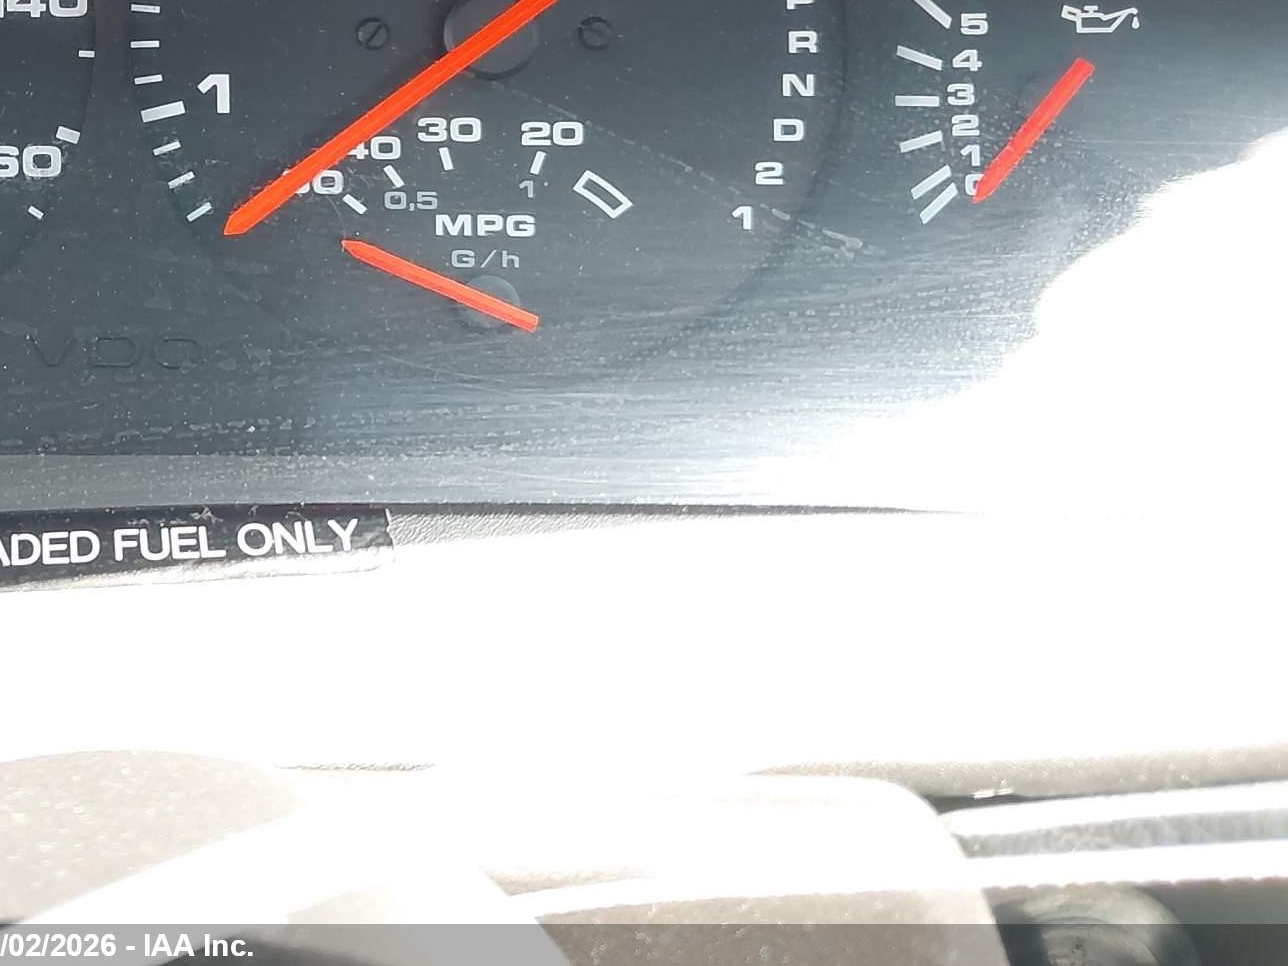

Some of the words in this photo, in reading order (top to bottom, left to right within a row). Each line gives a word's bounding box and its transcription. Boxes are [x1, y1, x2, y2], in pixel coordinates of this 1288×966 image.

[960, 13, 989, 35] 5
[787, 30, 819, 54] R
[952, 49, 983, 71] 4
[197, 73, 231, 114] 1
[782, 73, 815, 97] N
[947, 83, 975, 106] 3
[417, 116, 482, 143] 30
[520, 121, 584, 146] 20
[773, 119, 805, 142] D
[951, 114, 980, 137] 2
[960, 144, 981, 166] 1
[754, 161, 785, 186] 2
[384, 191, 438, 211] 0,5
[518, 180, 534, 198] 1
[435, 213, 535, 238] MPG
[731, 205, 753, 230] 1
[113, 525, 226, 563] FUEL
[236, 518, 358, 557] ONLY
